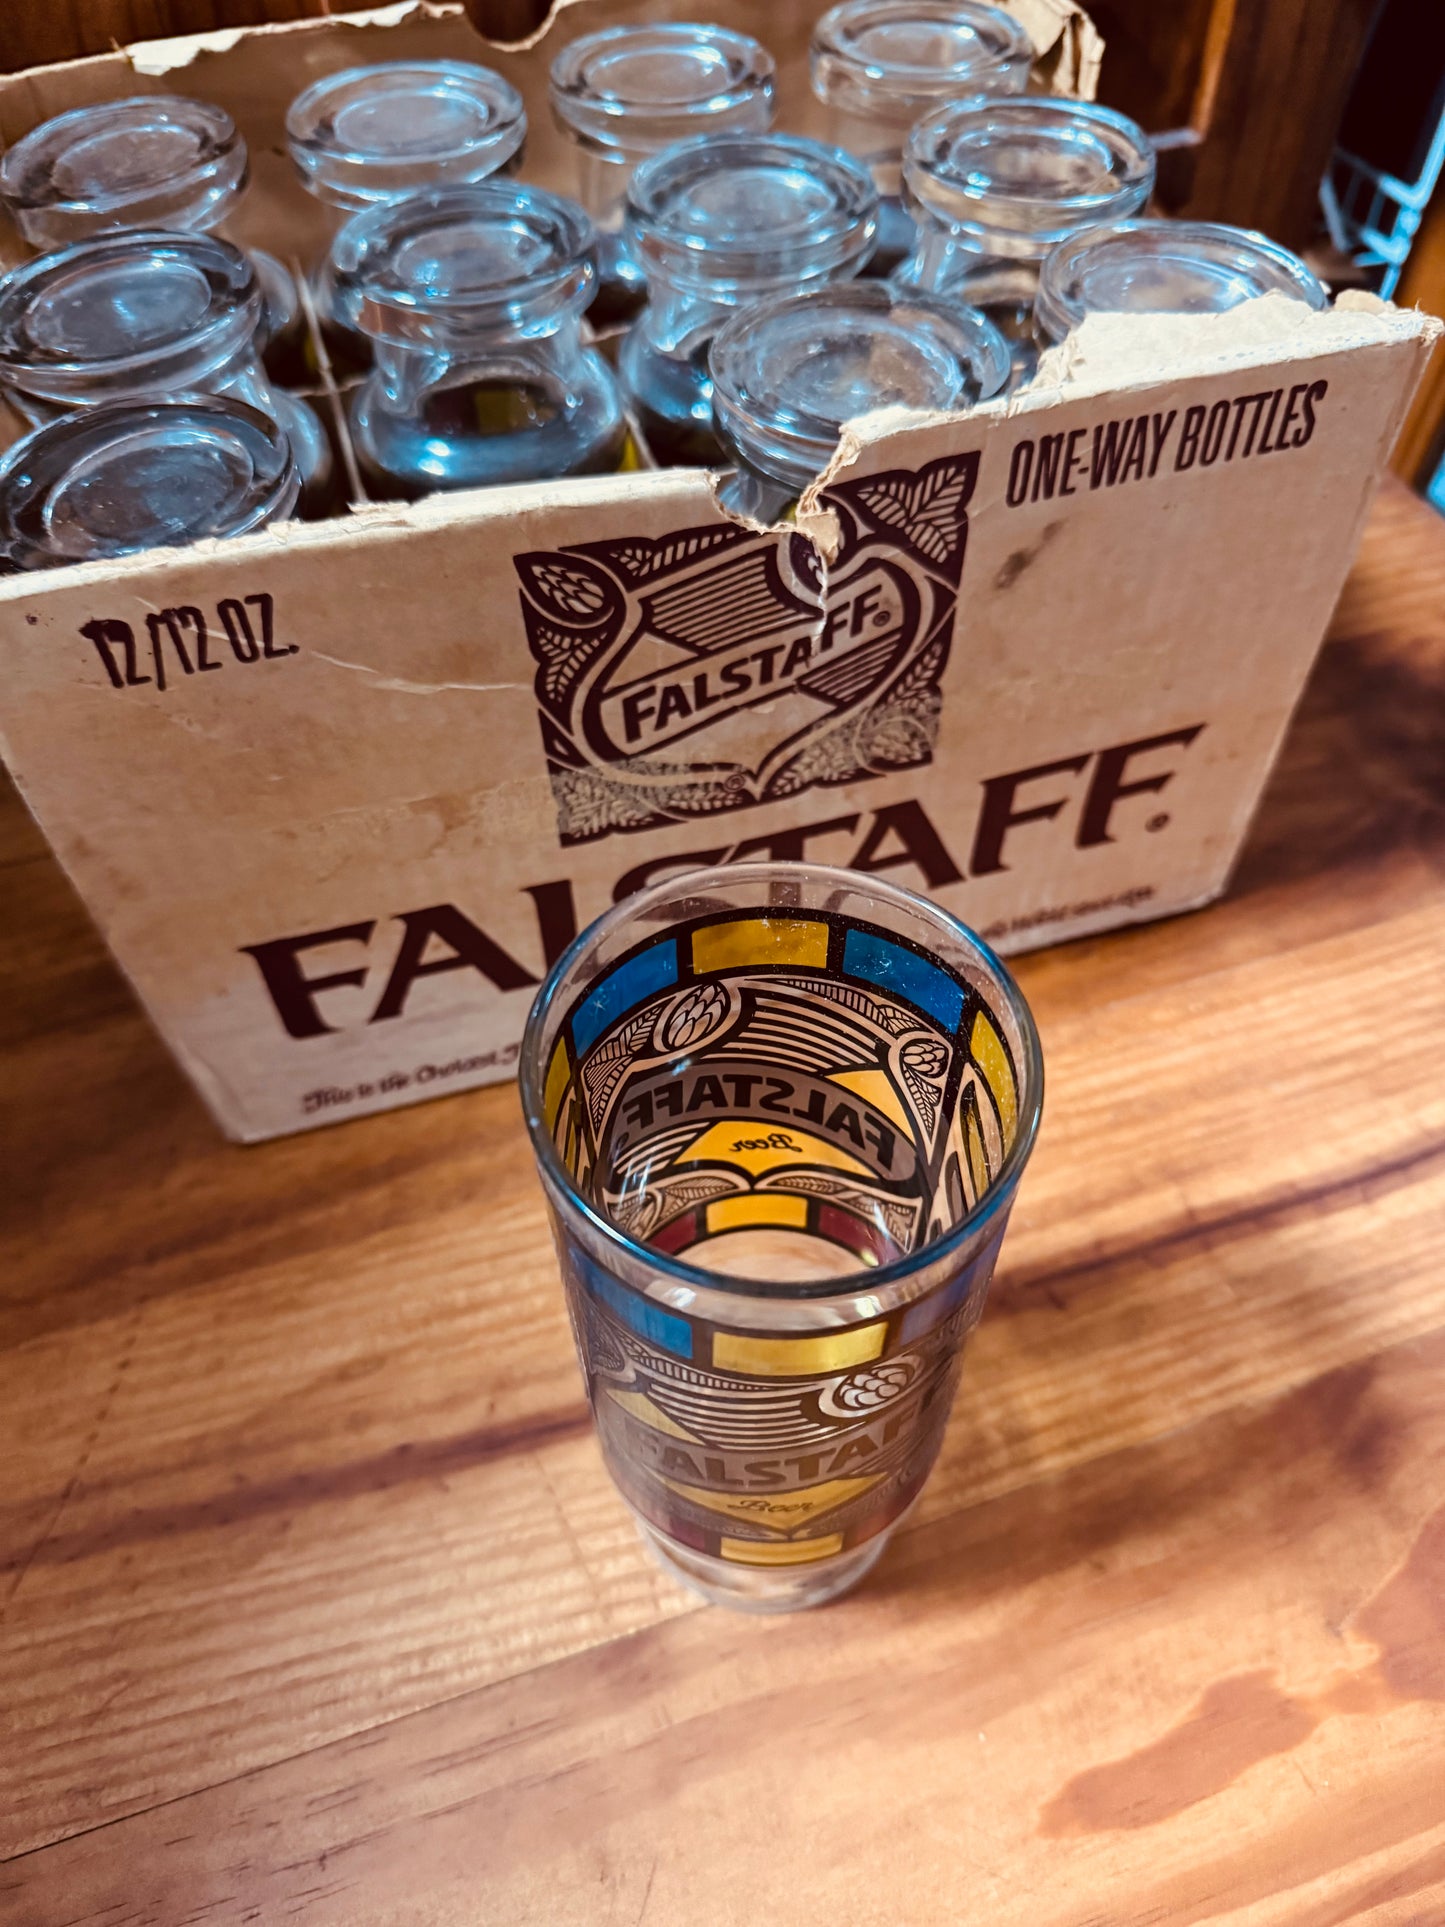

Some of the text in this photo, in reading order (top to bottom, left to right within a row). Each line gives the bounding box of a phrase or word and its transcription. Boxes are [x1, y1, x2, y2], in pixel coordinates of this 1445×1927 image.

[1005, 379, 1329, 509] ONE-WAY BOTTLES
[79, 606, 223, 692] 12/12
[726, 1498, 817, 1515] Beer
